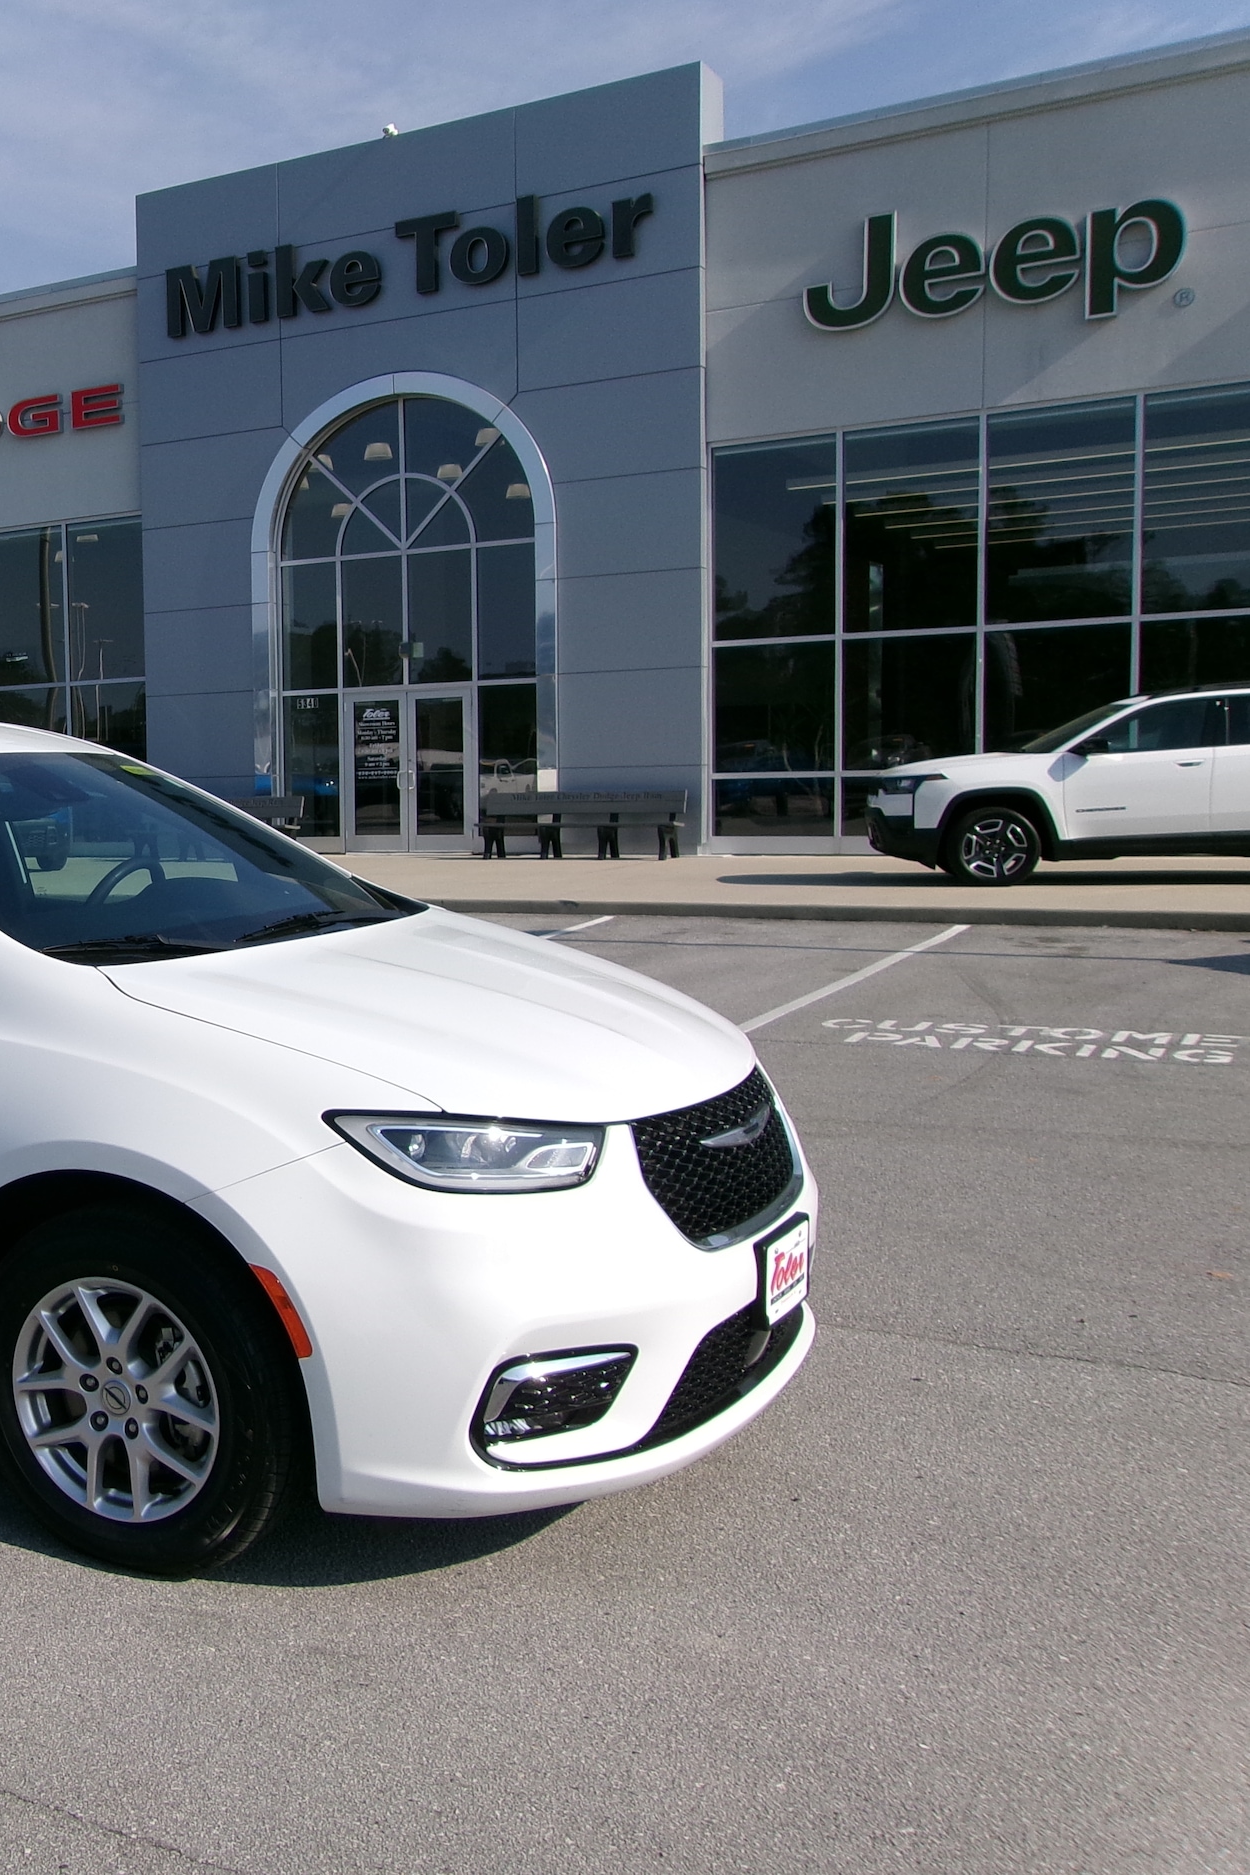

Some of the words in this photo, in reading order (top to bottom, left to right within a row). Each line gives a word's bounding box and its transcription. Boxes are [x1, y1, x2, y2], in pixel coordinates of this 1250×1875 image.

[165, 243, 382, 338] Mike
[395, 192, 654, 294] Toler
[803, 198, 1190, 331] Jeep
[843, 1031, 1235, 1064] PARKING
[770, 1251, 804, 1296] Toler
